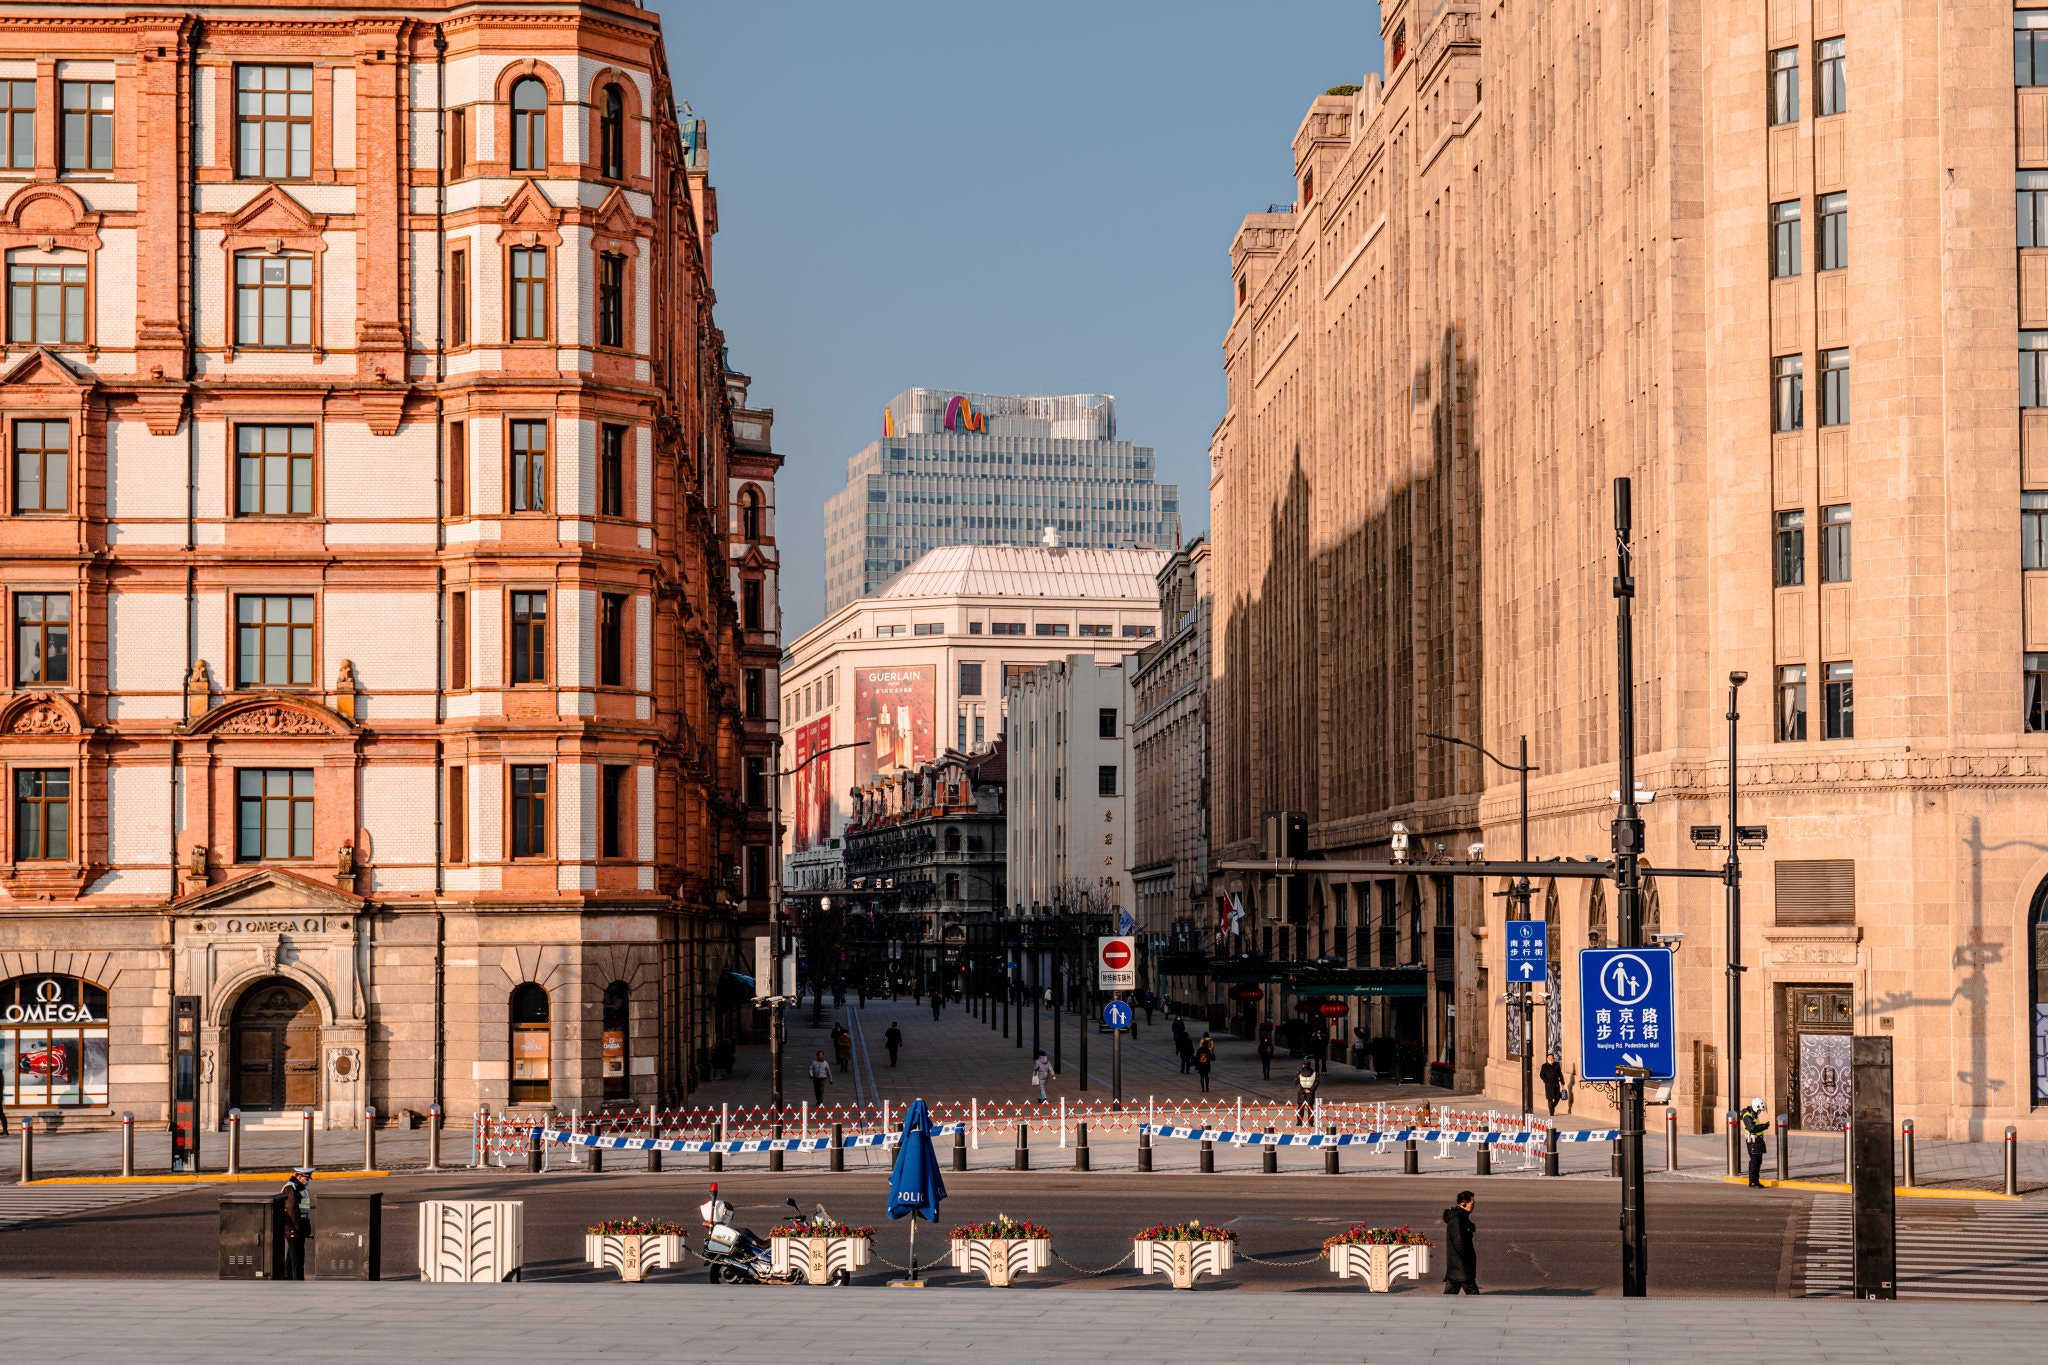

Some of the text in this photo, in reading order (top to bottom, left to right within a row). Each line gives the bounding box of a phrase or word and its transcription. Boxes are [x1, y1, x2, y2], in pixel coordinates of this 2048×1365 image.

[869, 671, 920, 682] GUERLAIN
[246, 921, 299, 933] OMEGA
[1510, 939, 1543, 947] 南京路
[1510, 948, 1543, 956] 步行街
[5, 1003, 94, 1023] OMEGA
[1595, 1008, 1658, 1024] 南京路
[1596, 1024, 1659, 1040] 步行街
[812, 1250, 823, 1271] 敬业
[993, 1251, 1005, 1273] 诚信
[1177, 1253, 1187, 1276] 友善
